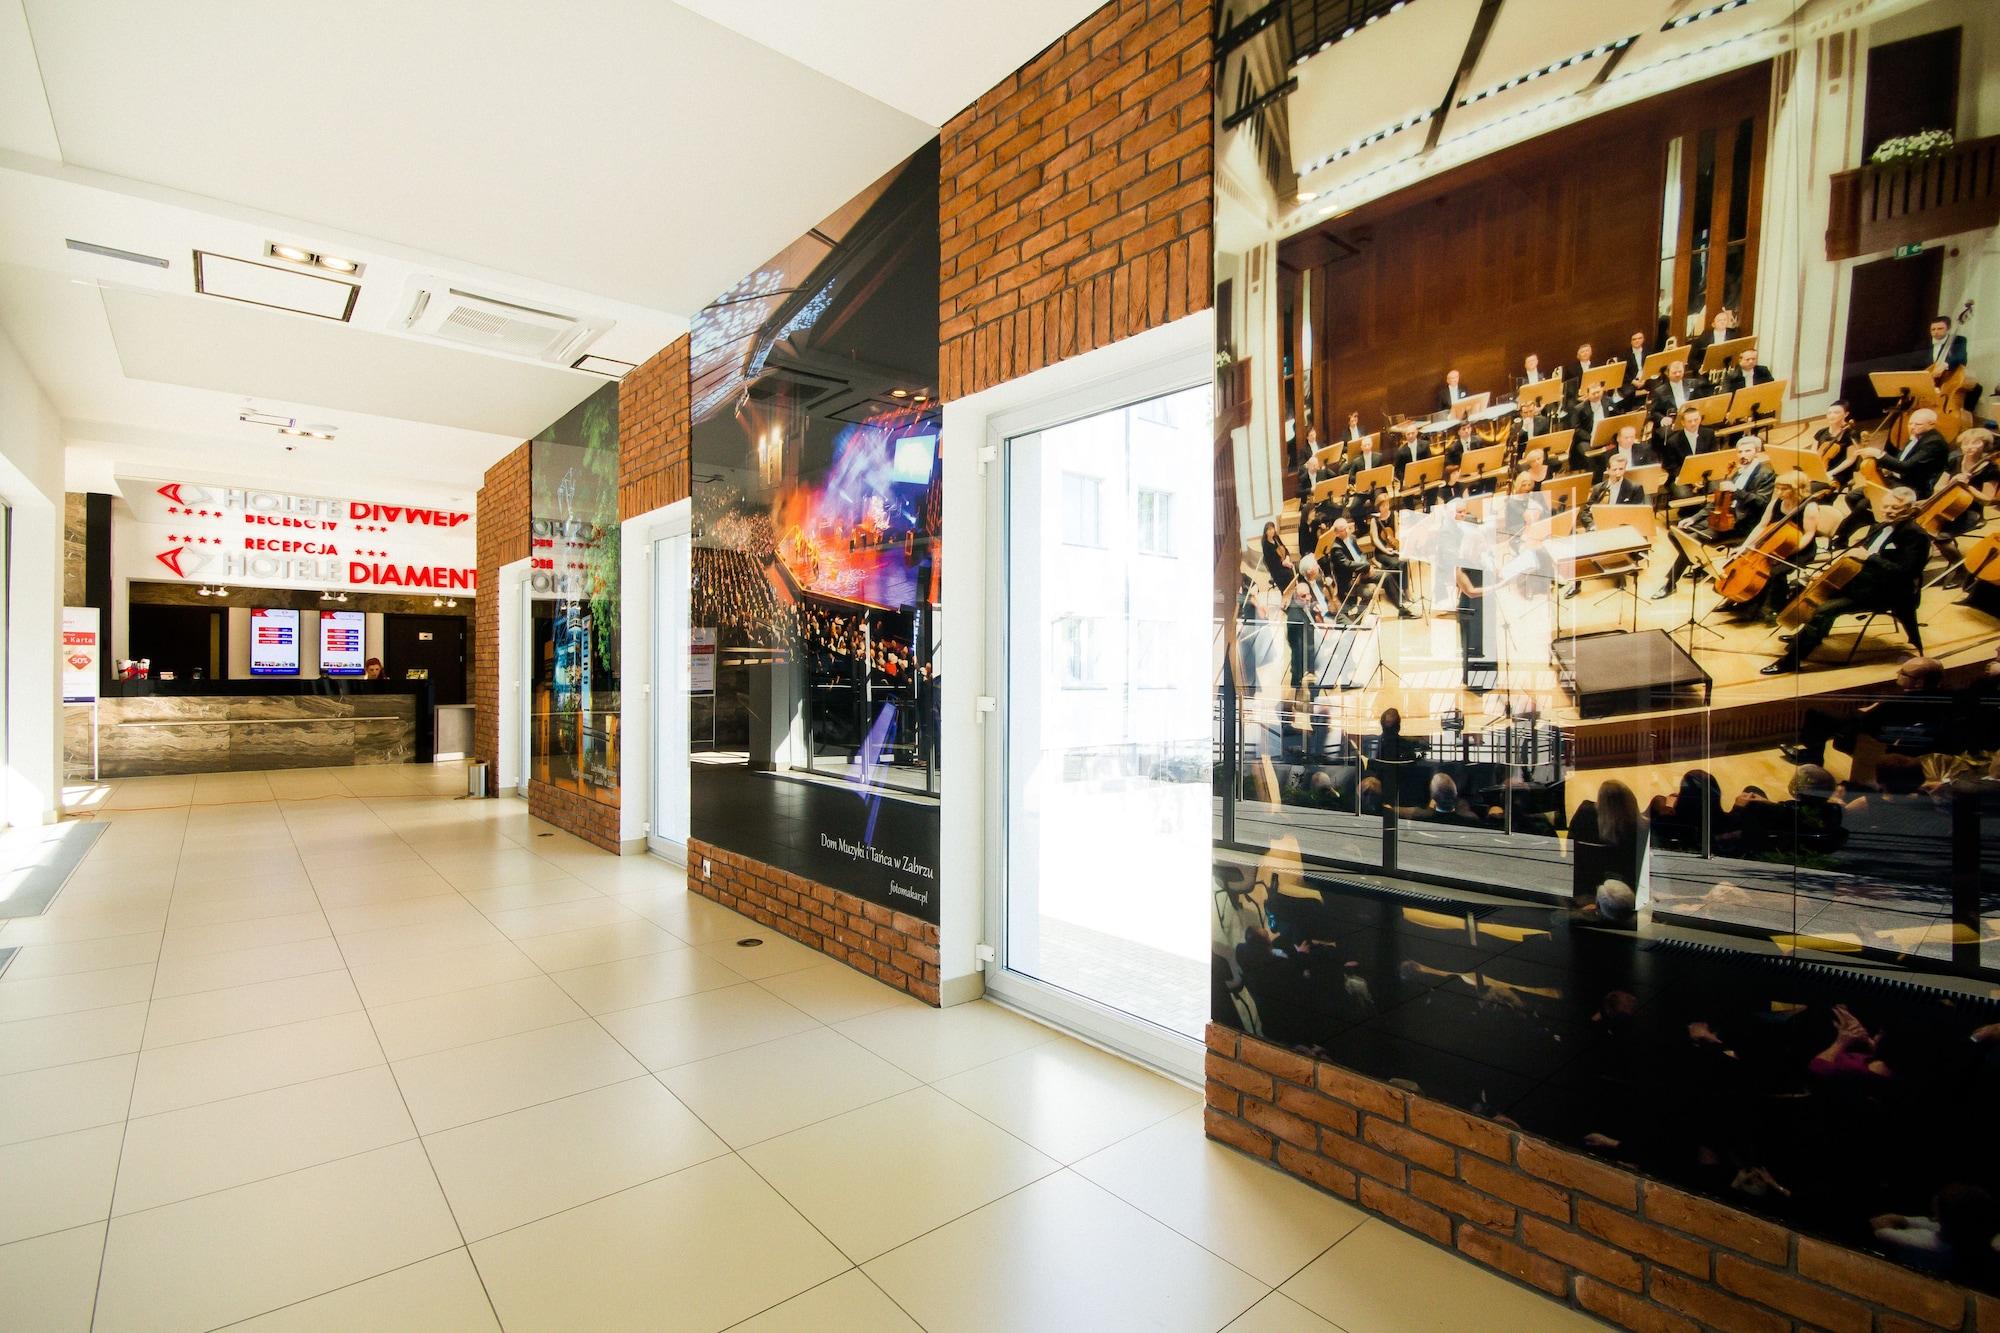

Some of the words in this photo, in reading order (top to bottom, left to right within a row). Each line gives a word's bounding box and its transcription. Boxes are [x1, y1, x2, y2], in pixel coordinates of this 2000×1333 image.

[245, 537, 338, 556] RECEPCJA
[223, 551, 342, 582] HOTELE
[349, 561, 478, 590] DIAMENT
[70, 636, 93, 644] Karta
[71, 657, 89, 665] 50%
[821, 833, 838, 850] Dom
[839, 838, 865, 860] Muzyki
[865, 847, 870, 860] i
[870, 847, 893, 866] Tańca
[893, 858, 902, 869] w
[902, 856, 934, 879] Zabrzu
